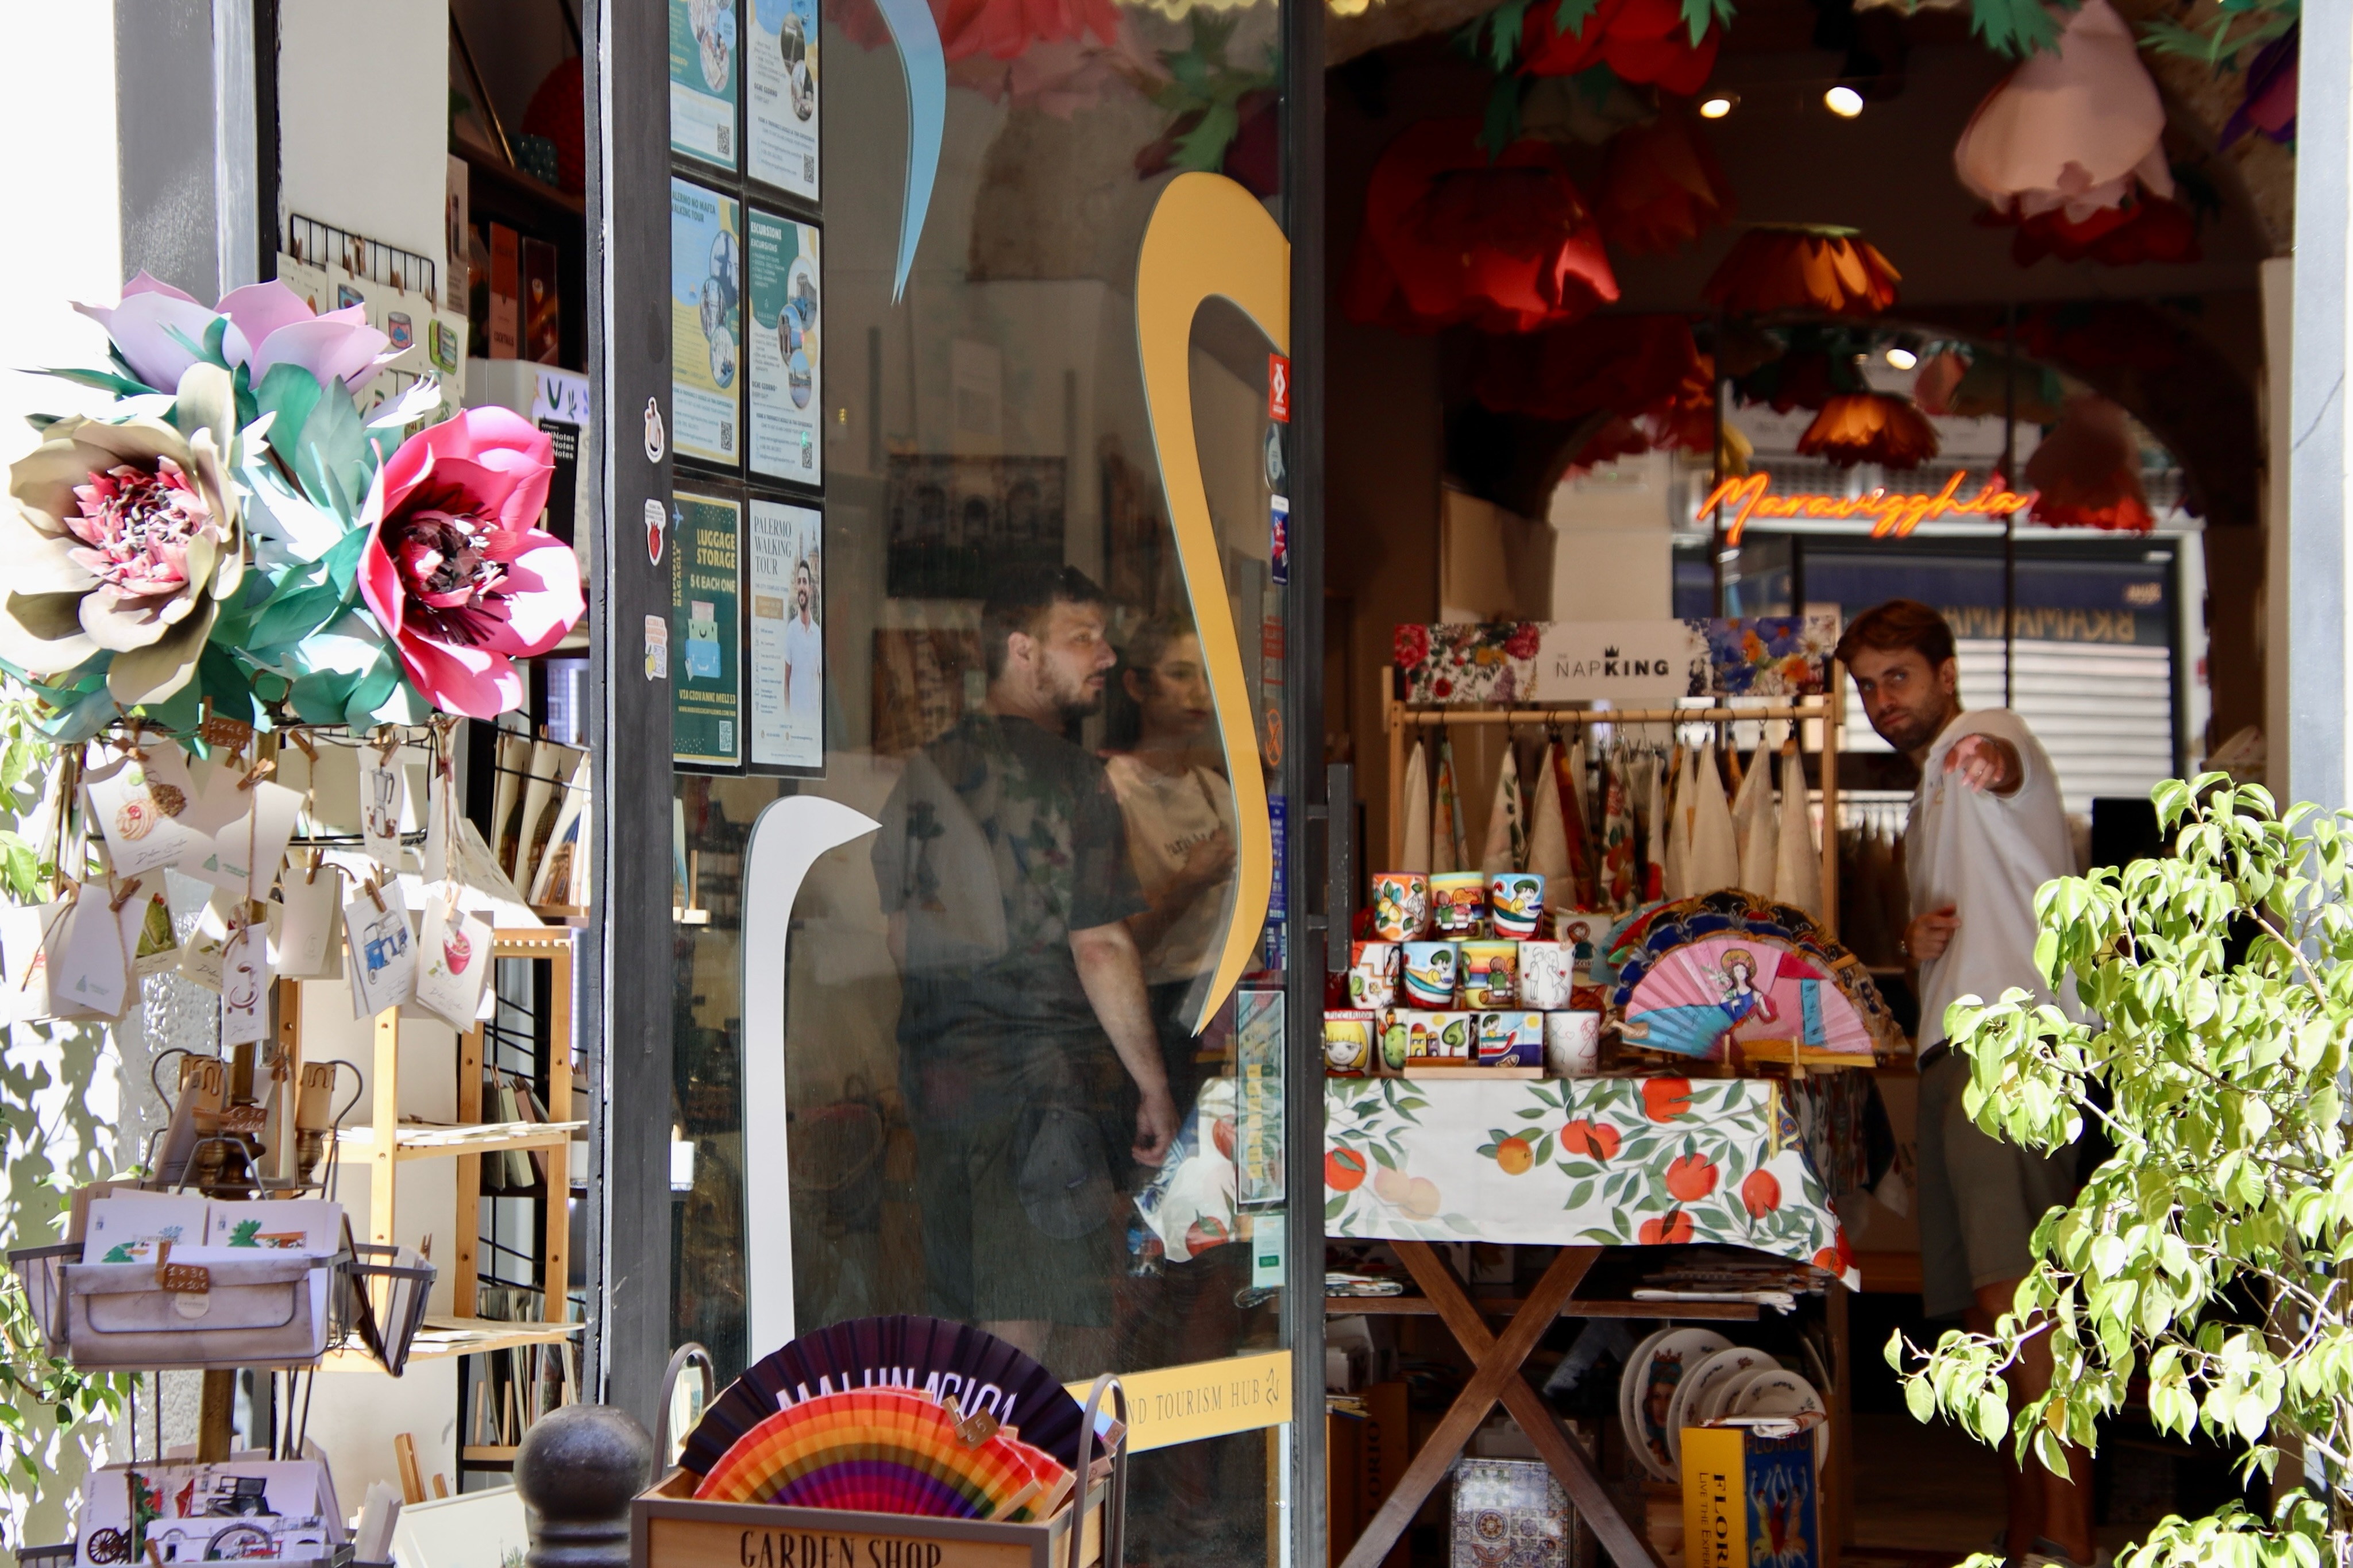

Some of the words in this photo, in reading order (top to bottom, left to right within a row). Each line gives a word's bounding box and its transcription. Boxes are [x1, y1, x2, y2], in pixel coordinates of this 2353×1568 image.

[672, 190, 691, 206] ALERMO
[692, 209, 704, 223] TOUR
[750, 221, 782, 240] ESCURSIONI
[750, 238, 778, 253] EXCURSIONS
[553, 431, 574, 442] Notes
[553, 440, 574, 451] Notes
[553, 449, 573, 459] Notes
[1696, 470, 2028, 546] Maravigghia
[754, 516, 792, 538] PALERMO
[697, 528, 736, 550] LUGGAGE
[754, 535, 792, 558] WALKING
[696, 547, 736, 570] STORAGE
[755, 555, 778, 576] TOUR
[690, 573, 696, 589] 5
[701, 576, 720, 592] EACH
[720, 578, 736, 594] ONE
[1556, 660, 1669, 677] NAPKING
[678, 689, 689, 700] VIA
[689, 690, 715, 702] GIOVANNI
[715, 692, 729, 704] MELI
[168, 1266, 176, 1277] 1
[1156, 1384, 1222, 1421] TOURISM
[1230, 1378, 1260, 1408] HUB
[1699, 1472, 1709, 1499] LIVE
[1700, 1503, 1708, 1526] THE
[1714, 1474, 1730, 1568] FLOR
[739, 1530, 856, 1568] GARDEN
[867, 1538, 942, 1568] SHOP
